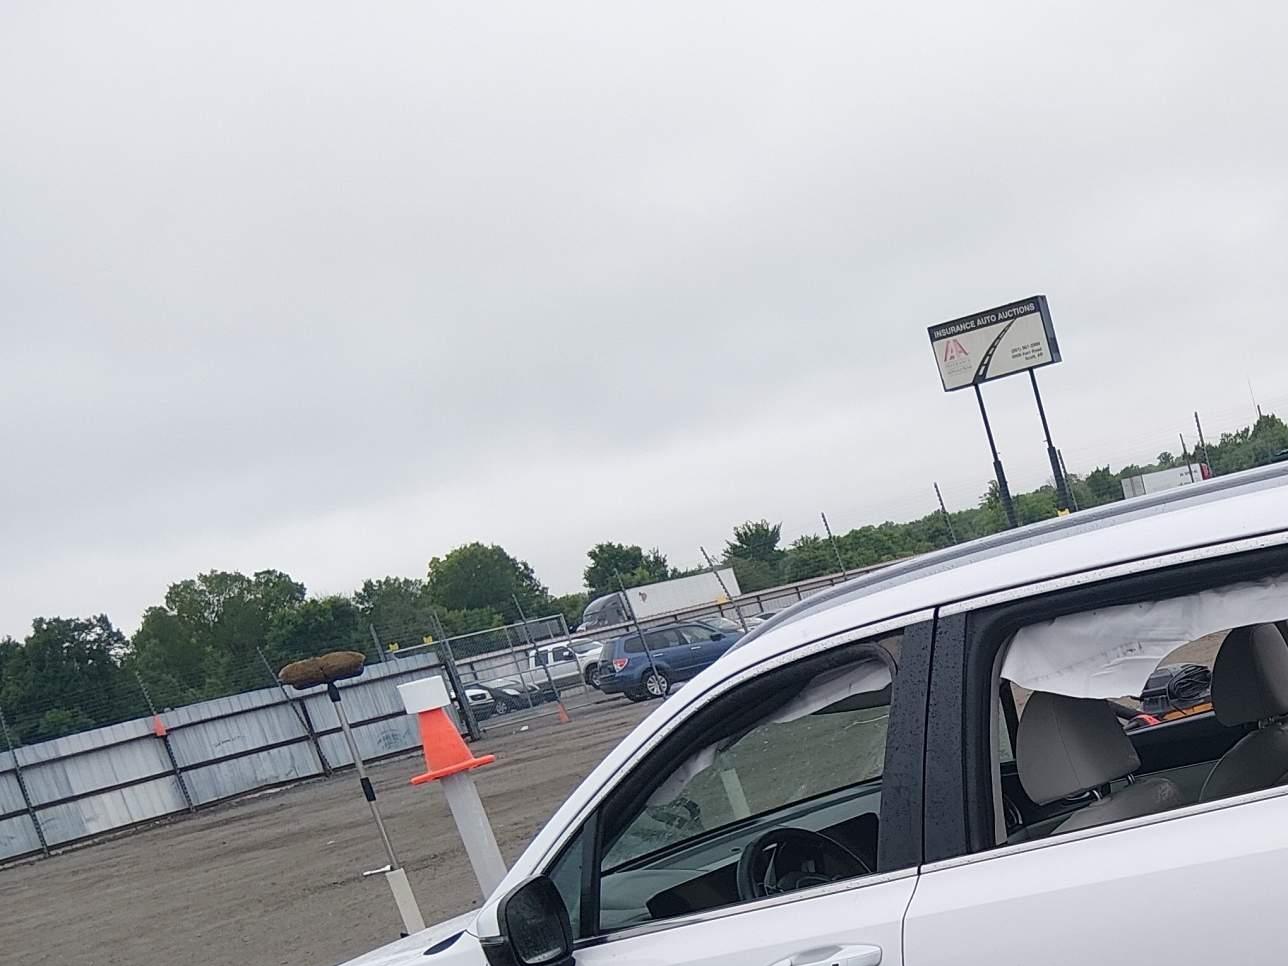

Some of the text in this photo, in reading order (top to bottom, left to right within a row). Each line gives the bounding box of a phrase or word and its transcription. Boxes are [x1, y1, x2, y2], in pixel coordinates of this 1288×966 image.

[933, 302, 1035, 339] INSURANCE AUTO AUCTIONS
